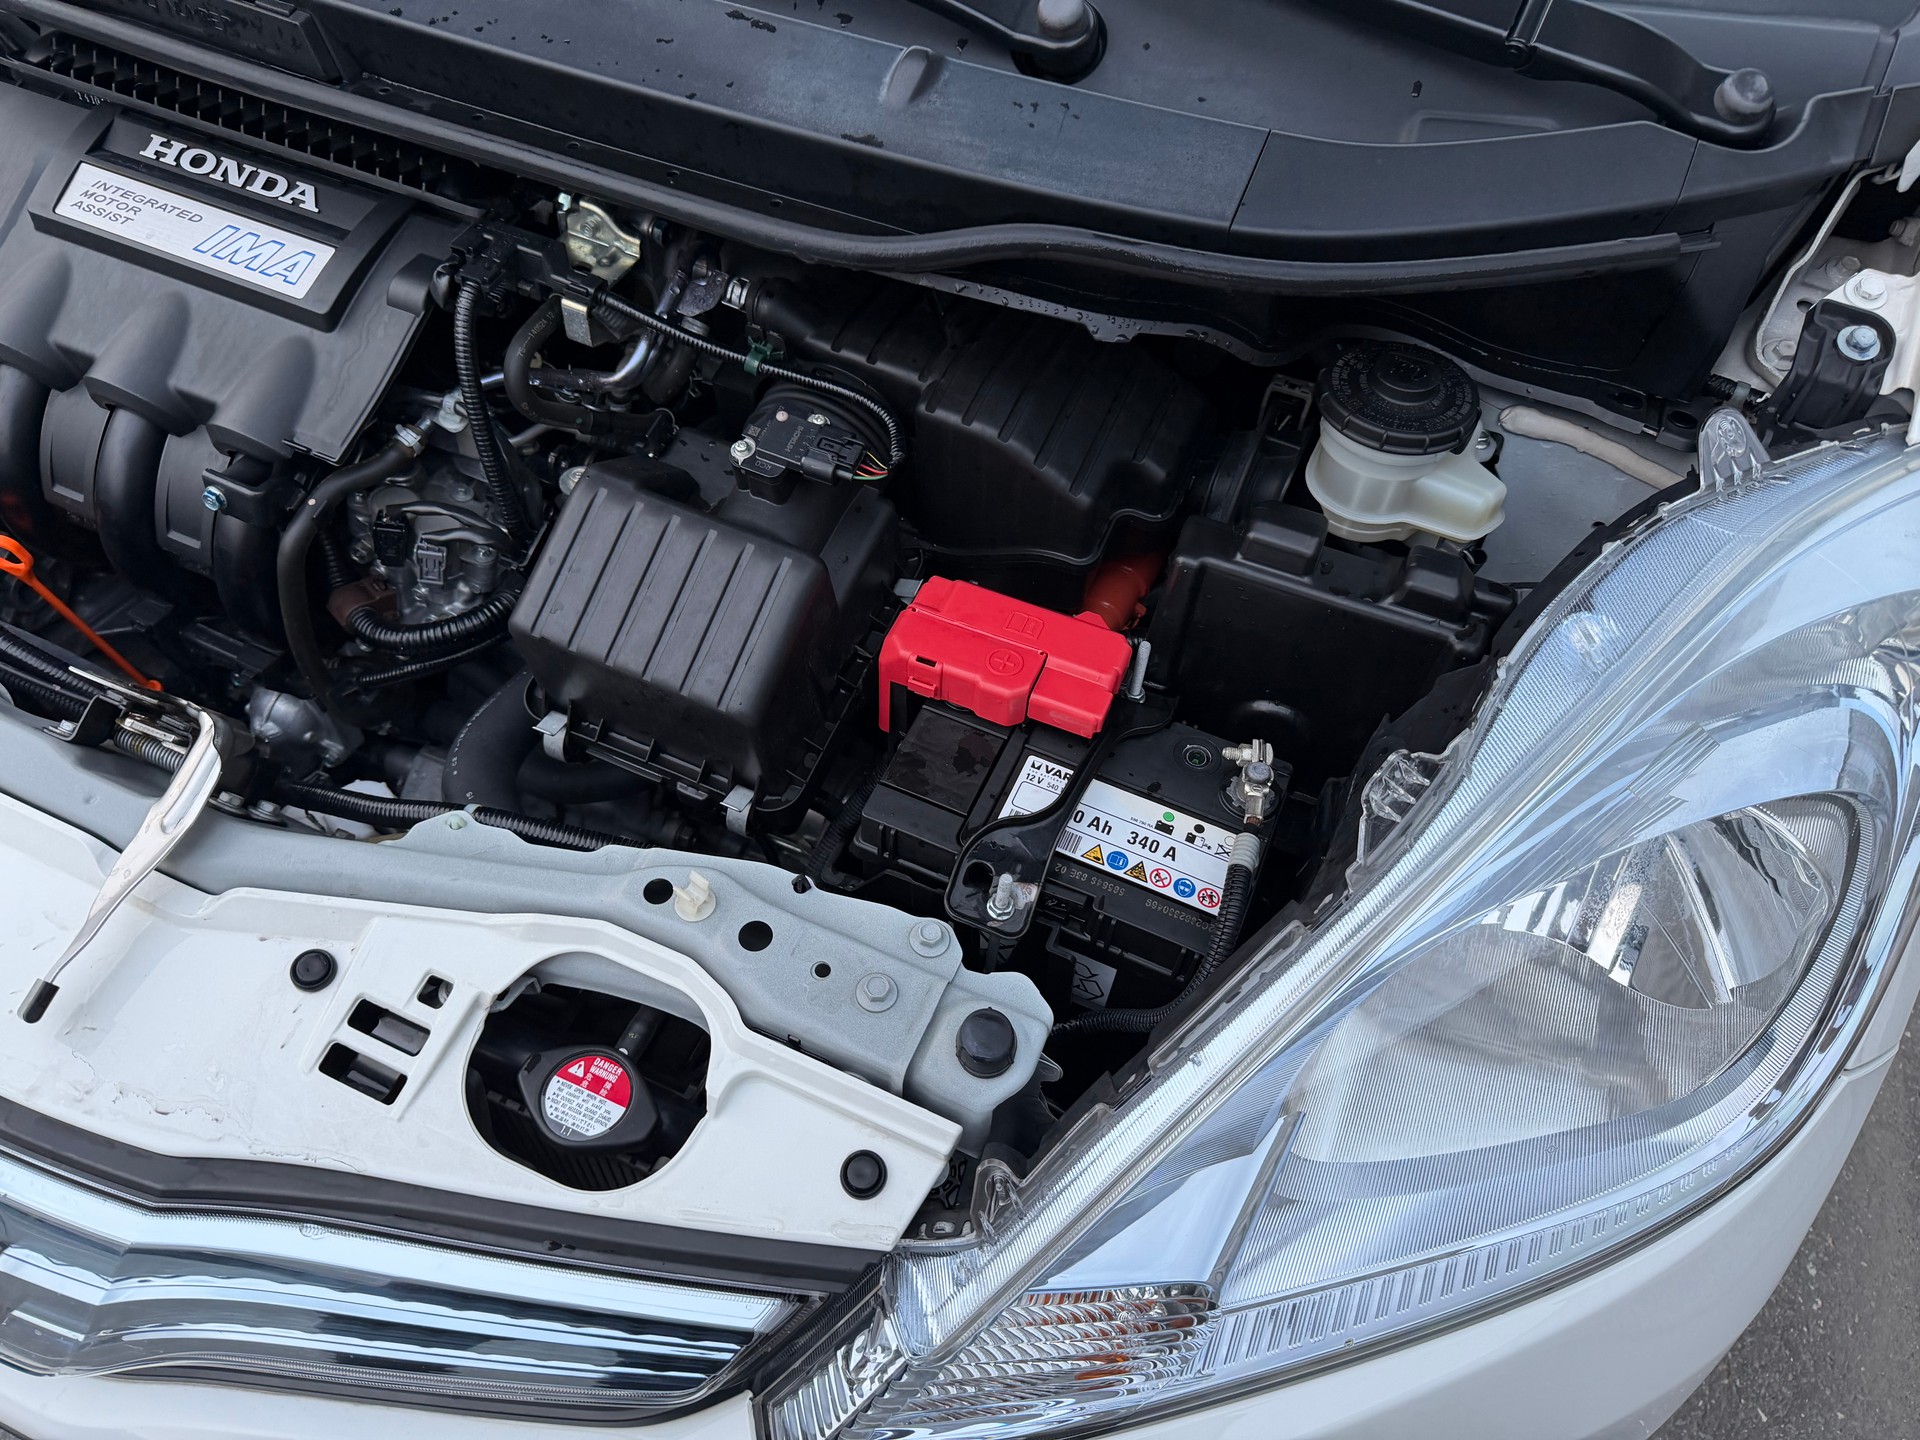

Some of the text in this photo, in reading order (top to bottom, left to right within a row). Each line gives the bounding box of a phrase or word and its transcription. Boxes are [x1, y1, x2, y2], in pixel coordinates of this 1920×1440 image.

[139, 134, 320, 213] HONDA
[70, 200, 135, 226] ASSIST
[79, 189, 143, 216] MOTOR
[90, 180, 204, 223] INTEGRATED
[193, 224, 316, 286] IMA
[785, 426, 804, 452] HITACHI
[1026, 773, 1059, 791] 12 V 540
[1045, 764, 1073, 781] VAR
[1073, 810, 1177, 862] 0 Ah 340 A
[1054, 862, 1068, 874] 02
[589, 1064, 619, 1084] WARNUNG
[594, 1057, 623, 1076] DANGER
[573, 1086, 584, 1095] OPEN
[560, 1125, 573, 1137] 1.1
